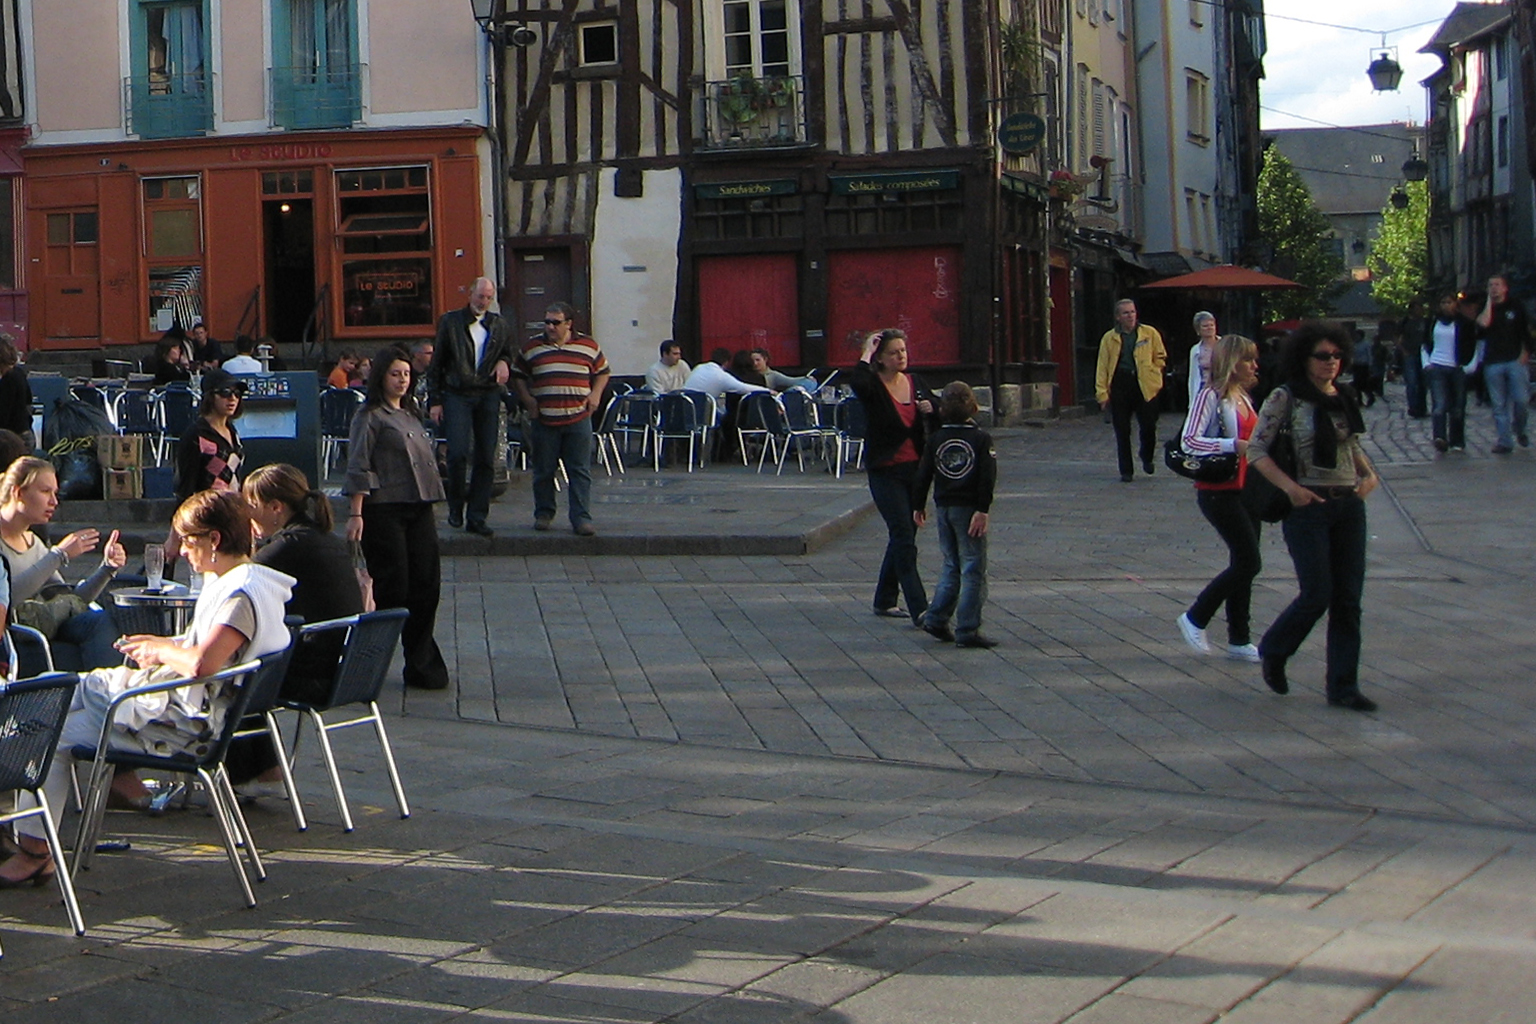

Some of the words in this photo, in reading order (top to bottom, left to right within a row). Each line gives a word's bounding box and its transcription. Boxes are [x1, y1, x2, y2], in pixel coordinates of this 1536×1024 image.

[230, 146, 252, 162] Le
[719, 182, 772, 196] Sandwiches
[848, 179, 883, 193] Salades
[359, 282, 373, 291] Le
